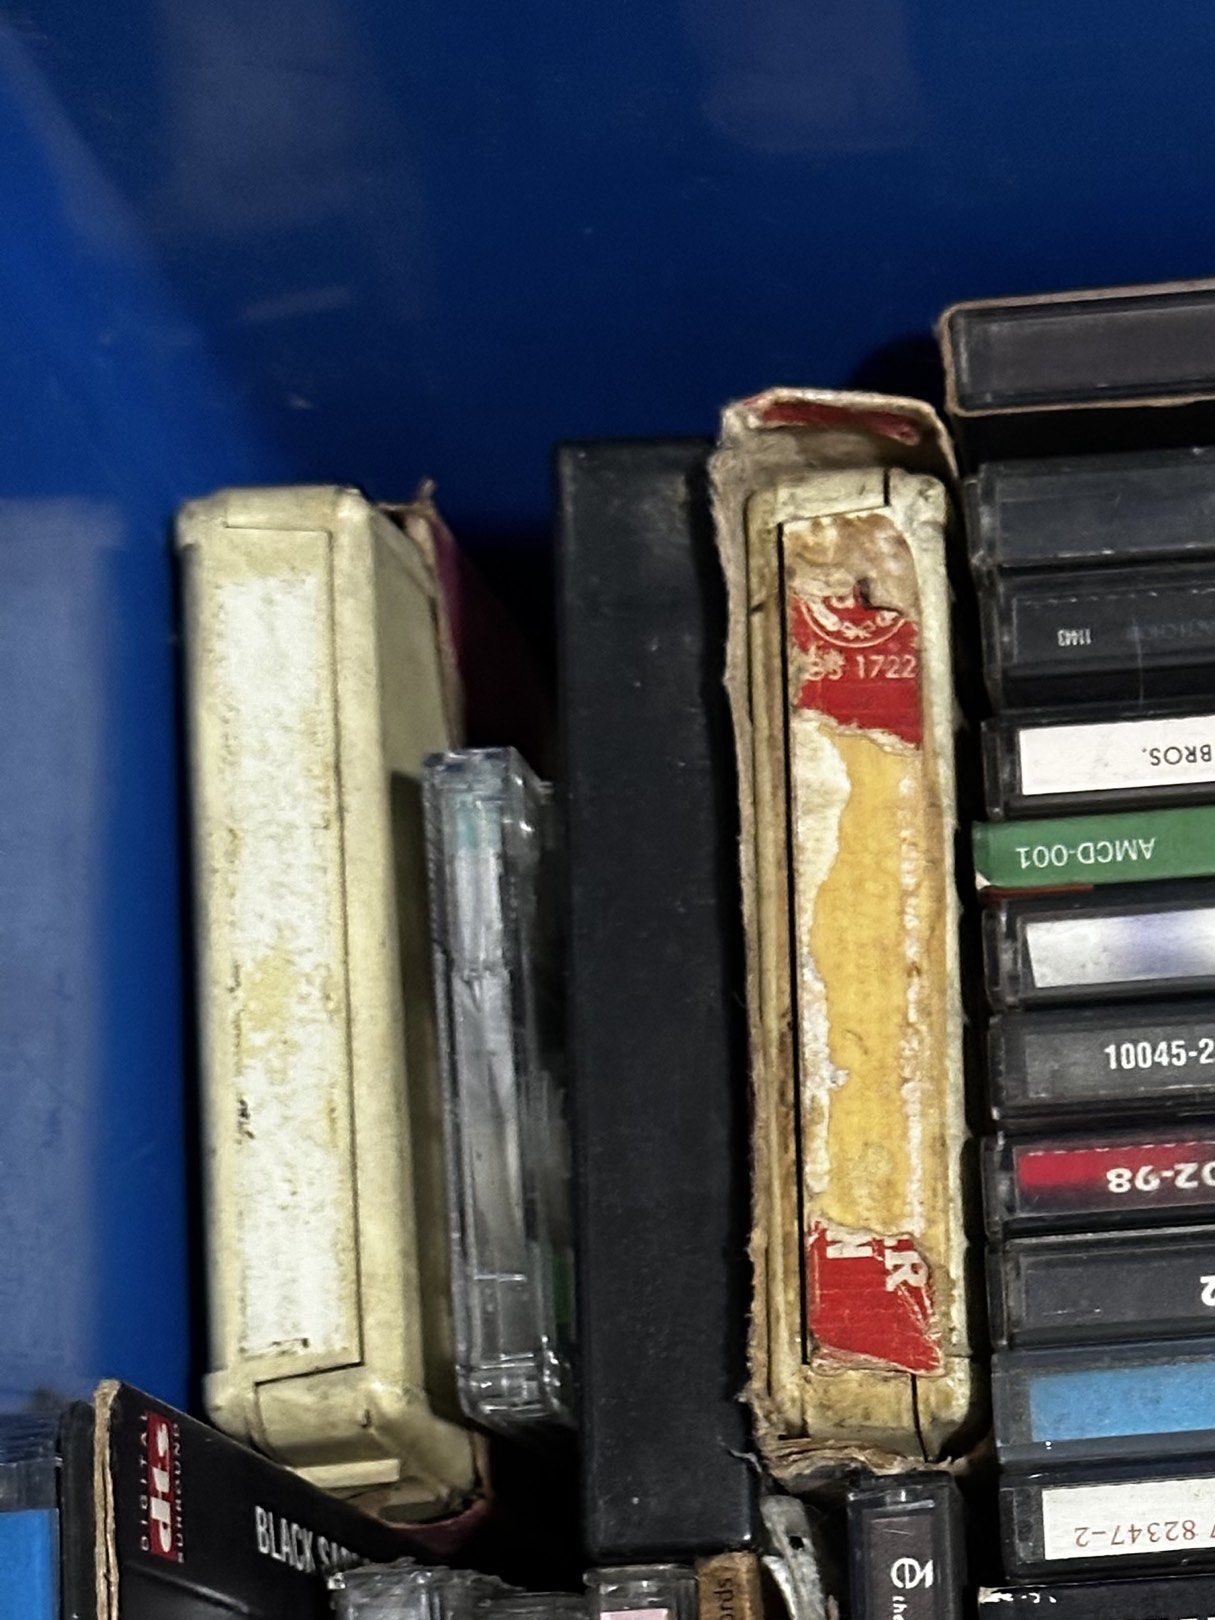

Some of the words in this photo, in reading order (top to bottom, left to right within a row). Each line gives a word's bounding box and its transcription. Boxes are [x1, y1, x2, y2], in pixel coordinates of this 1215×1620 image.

[855, 655, 918, 679] 1722
[1142, 744, 1212, 767] BROS.
[1015, 837, 1156, 869] AMCD-001
[1074, 1519, 1198, 1548] 82347-2
